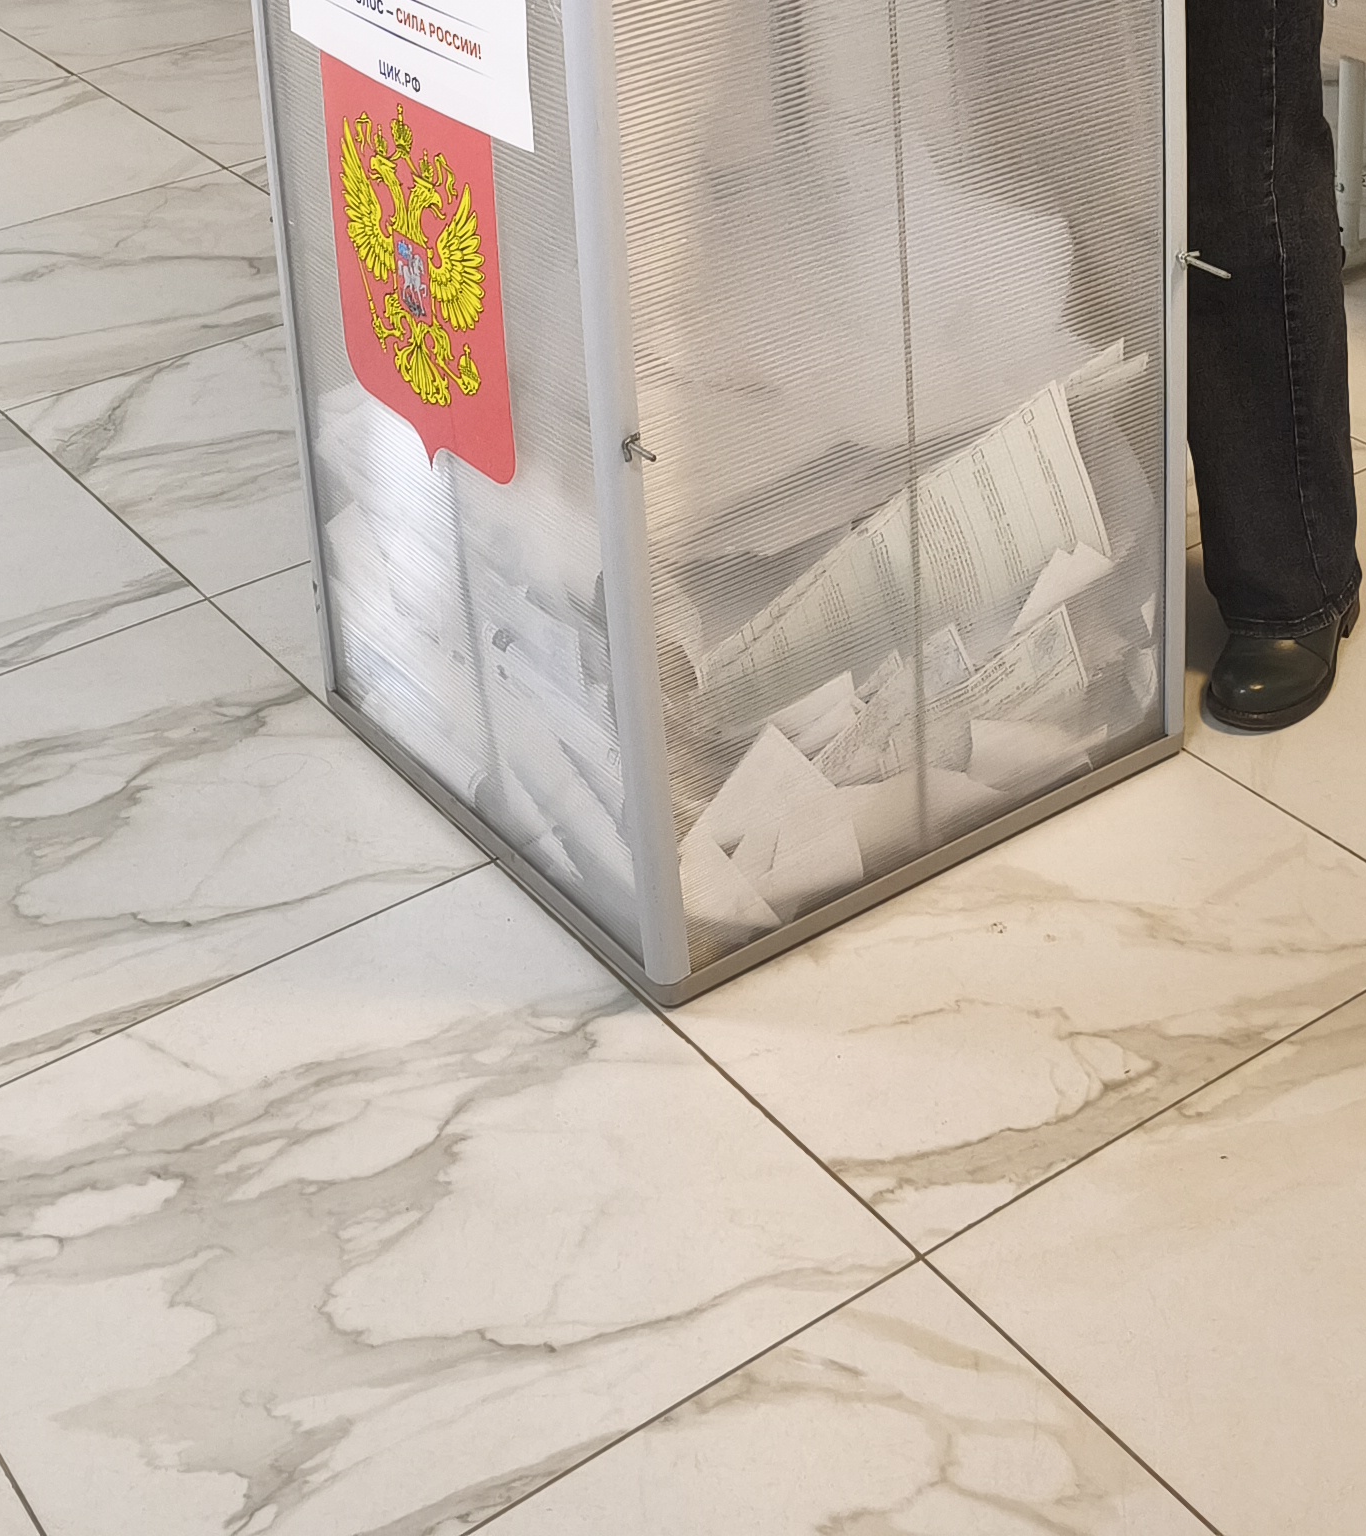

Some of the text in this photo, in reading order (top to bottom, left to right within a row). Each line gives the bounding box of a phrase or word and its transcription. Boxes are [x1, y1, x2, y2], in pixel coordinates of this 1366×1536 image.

[395, 7, 427, 37] СИЛА
[428, 21, 483, 61] РОССИИ!
[378, 58, 422, 94] ЦИК.РФ
